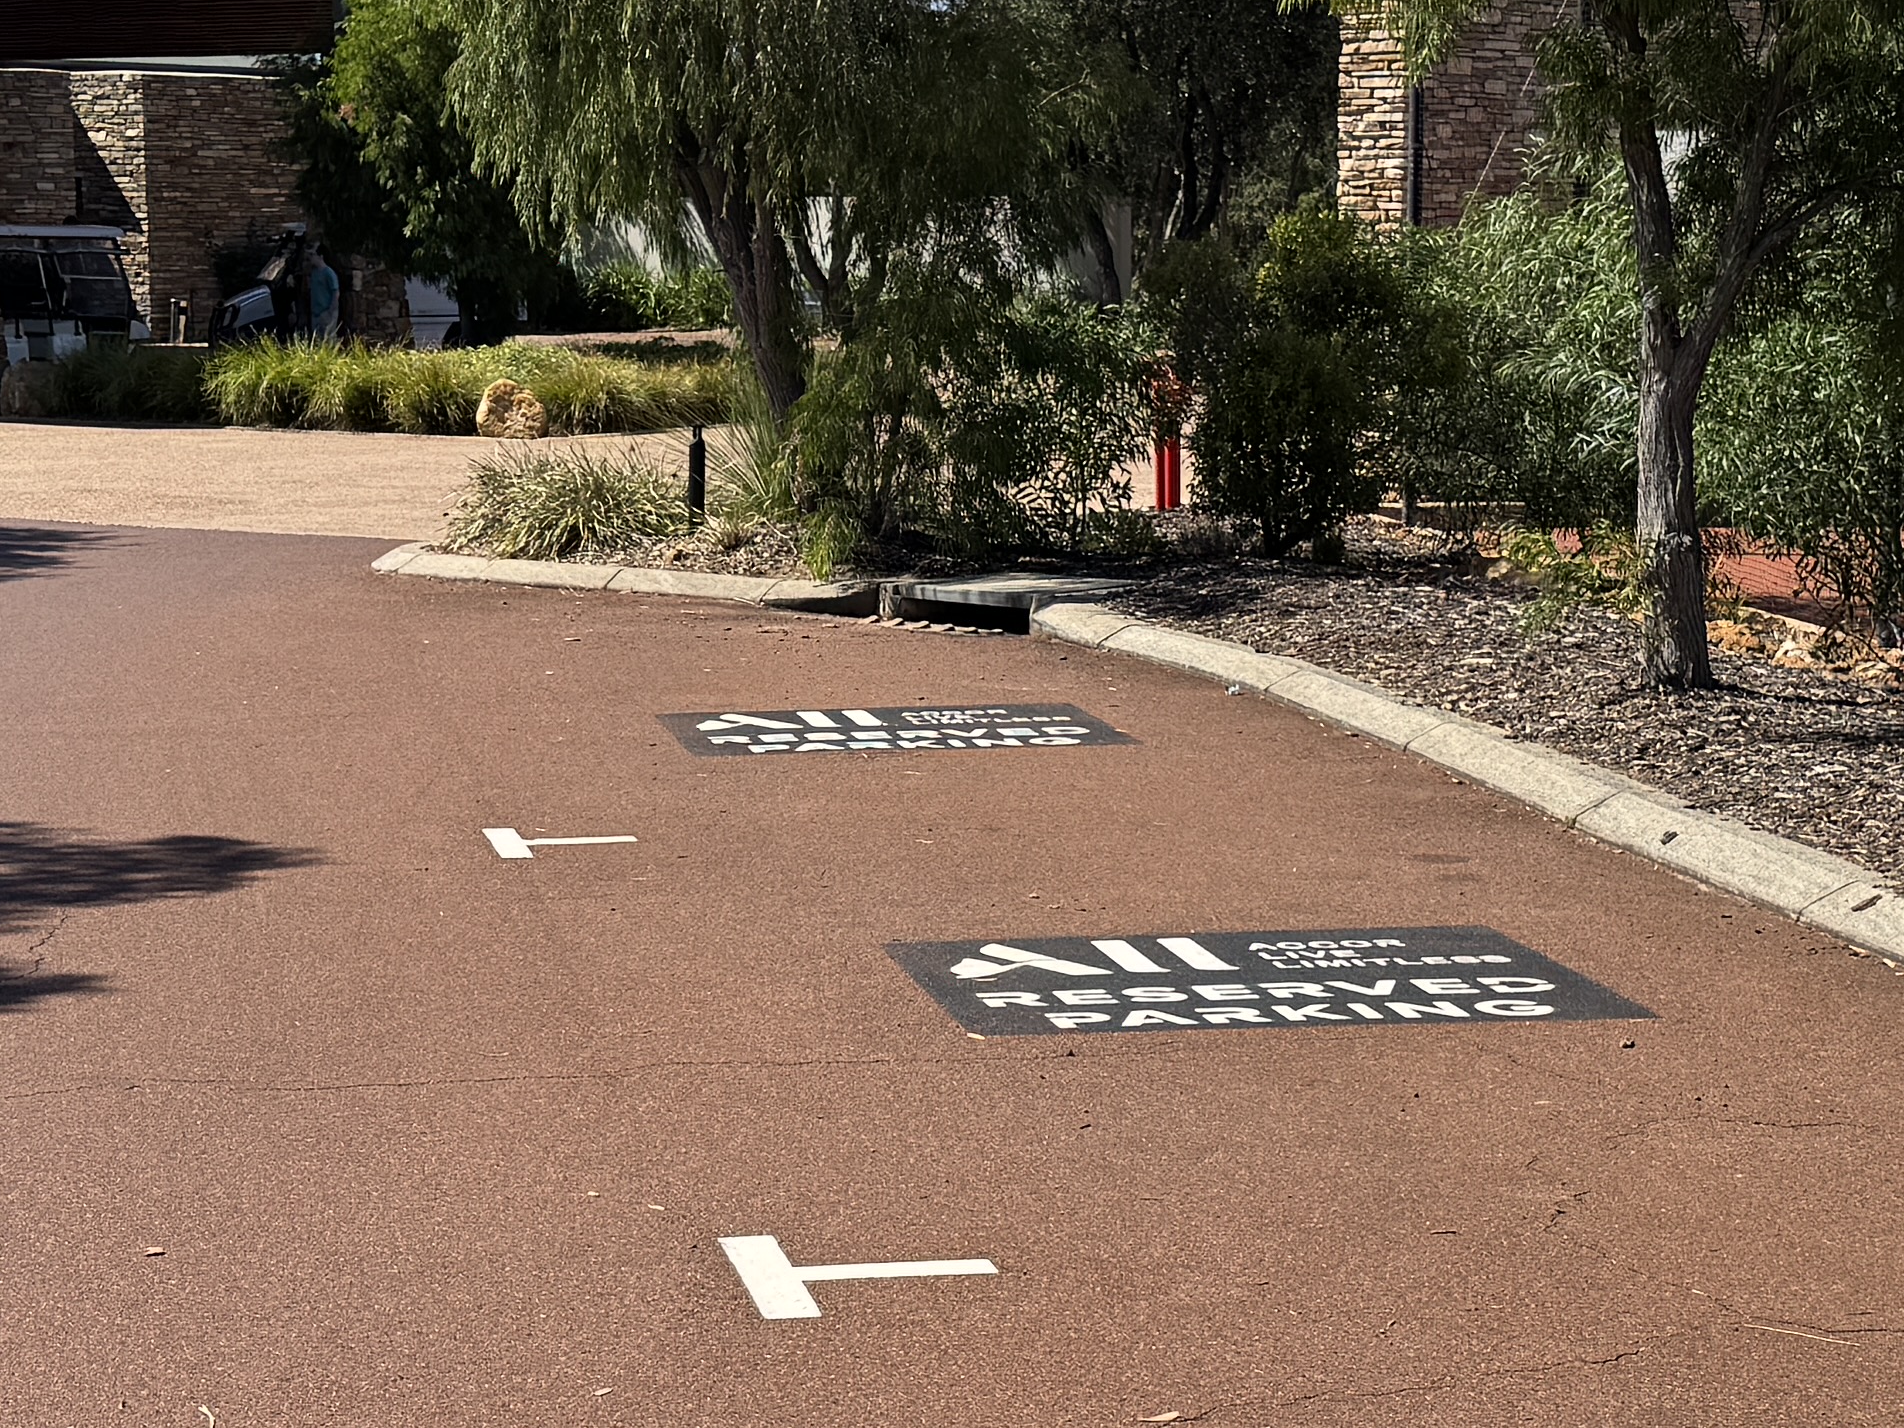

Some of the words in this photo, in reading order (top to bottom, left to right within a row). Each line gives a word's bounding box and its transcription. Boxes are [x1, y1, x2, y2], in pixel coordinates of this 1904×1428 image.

[707, 727, 1091, 745] RESERVED
[748, 737, 1082, 754] PARKING
[1257, 950, 1362, 960] LIVE
[1271, 955, 1512, 969] LIMITLESS
[975, 977, 1556, 1008] RESERVED
[1044, 1000, 1555, 1029] PARKING
